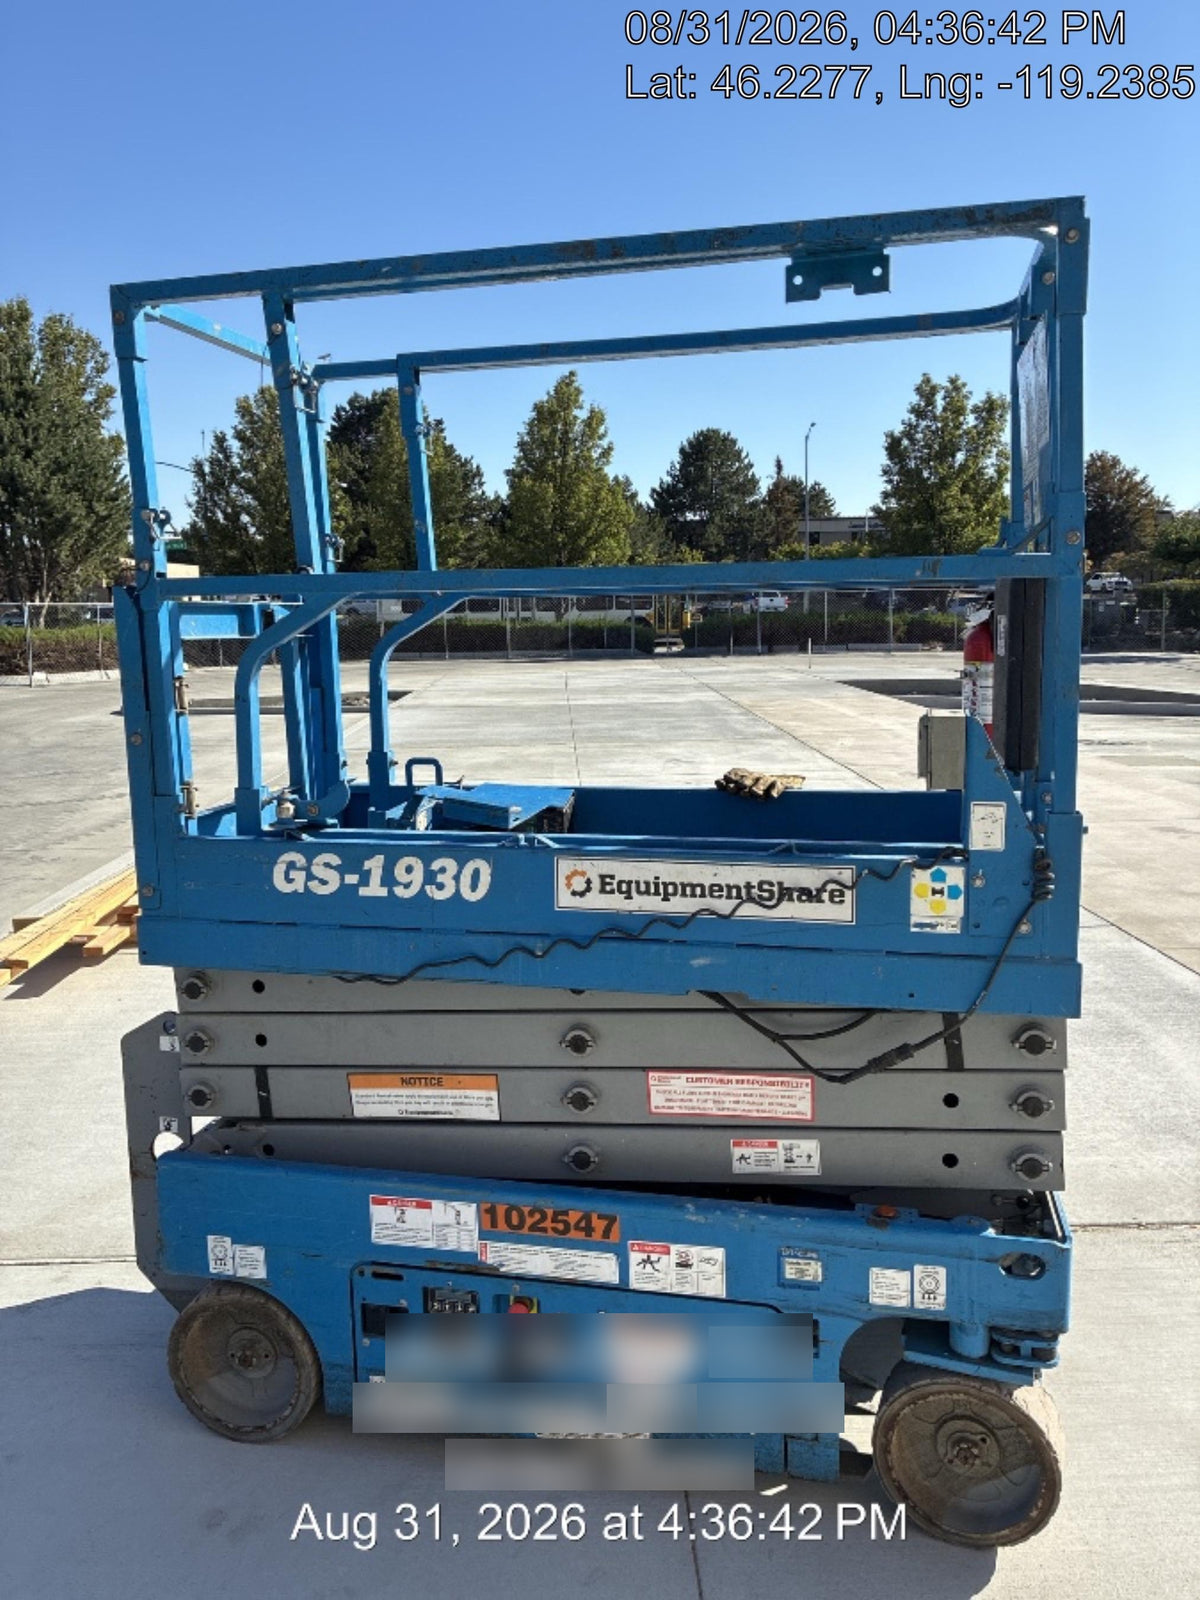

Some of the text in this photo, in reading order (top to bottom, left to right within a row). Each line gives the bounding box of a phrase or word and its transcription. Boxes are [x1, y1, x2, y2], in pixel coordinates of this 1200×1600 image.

[273, 851, 492, 902] GS-1930
[598, 874, 846, 905] EquipmentShare
[400, 1076, 444, 1087] NOTICE
[484, 1204, 617, 1240] 102547
